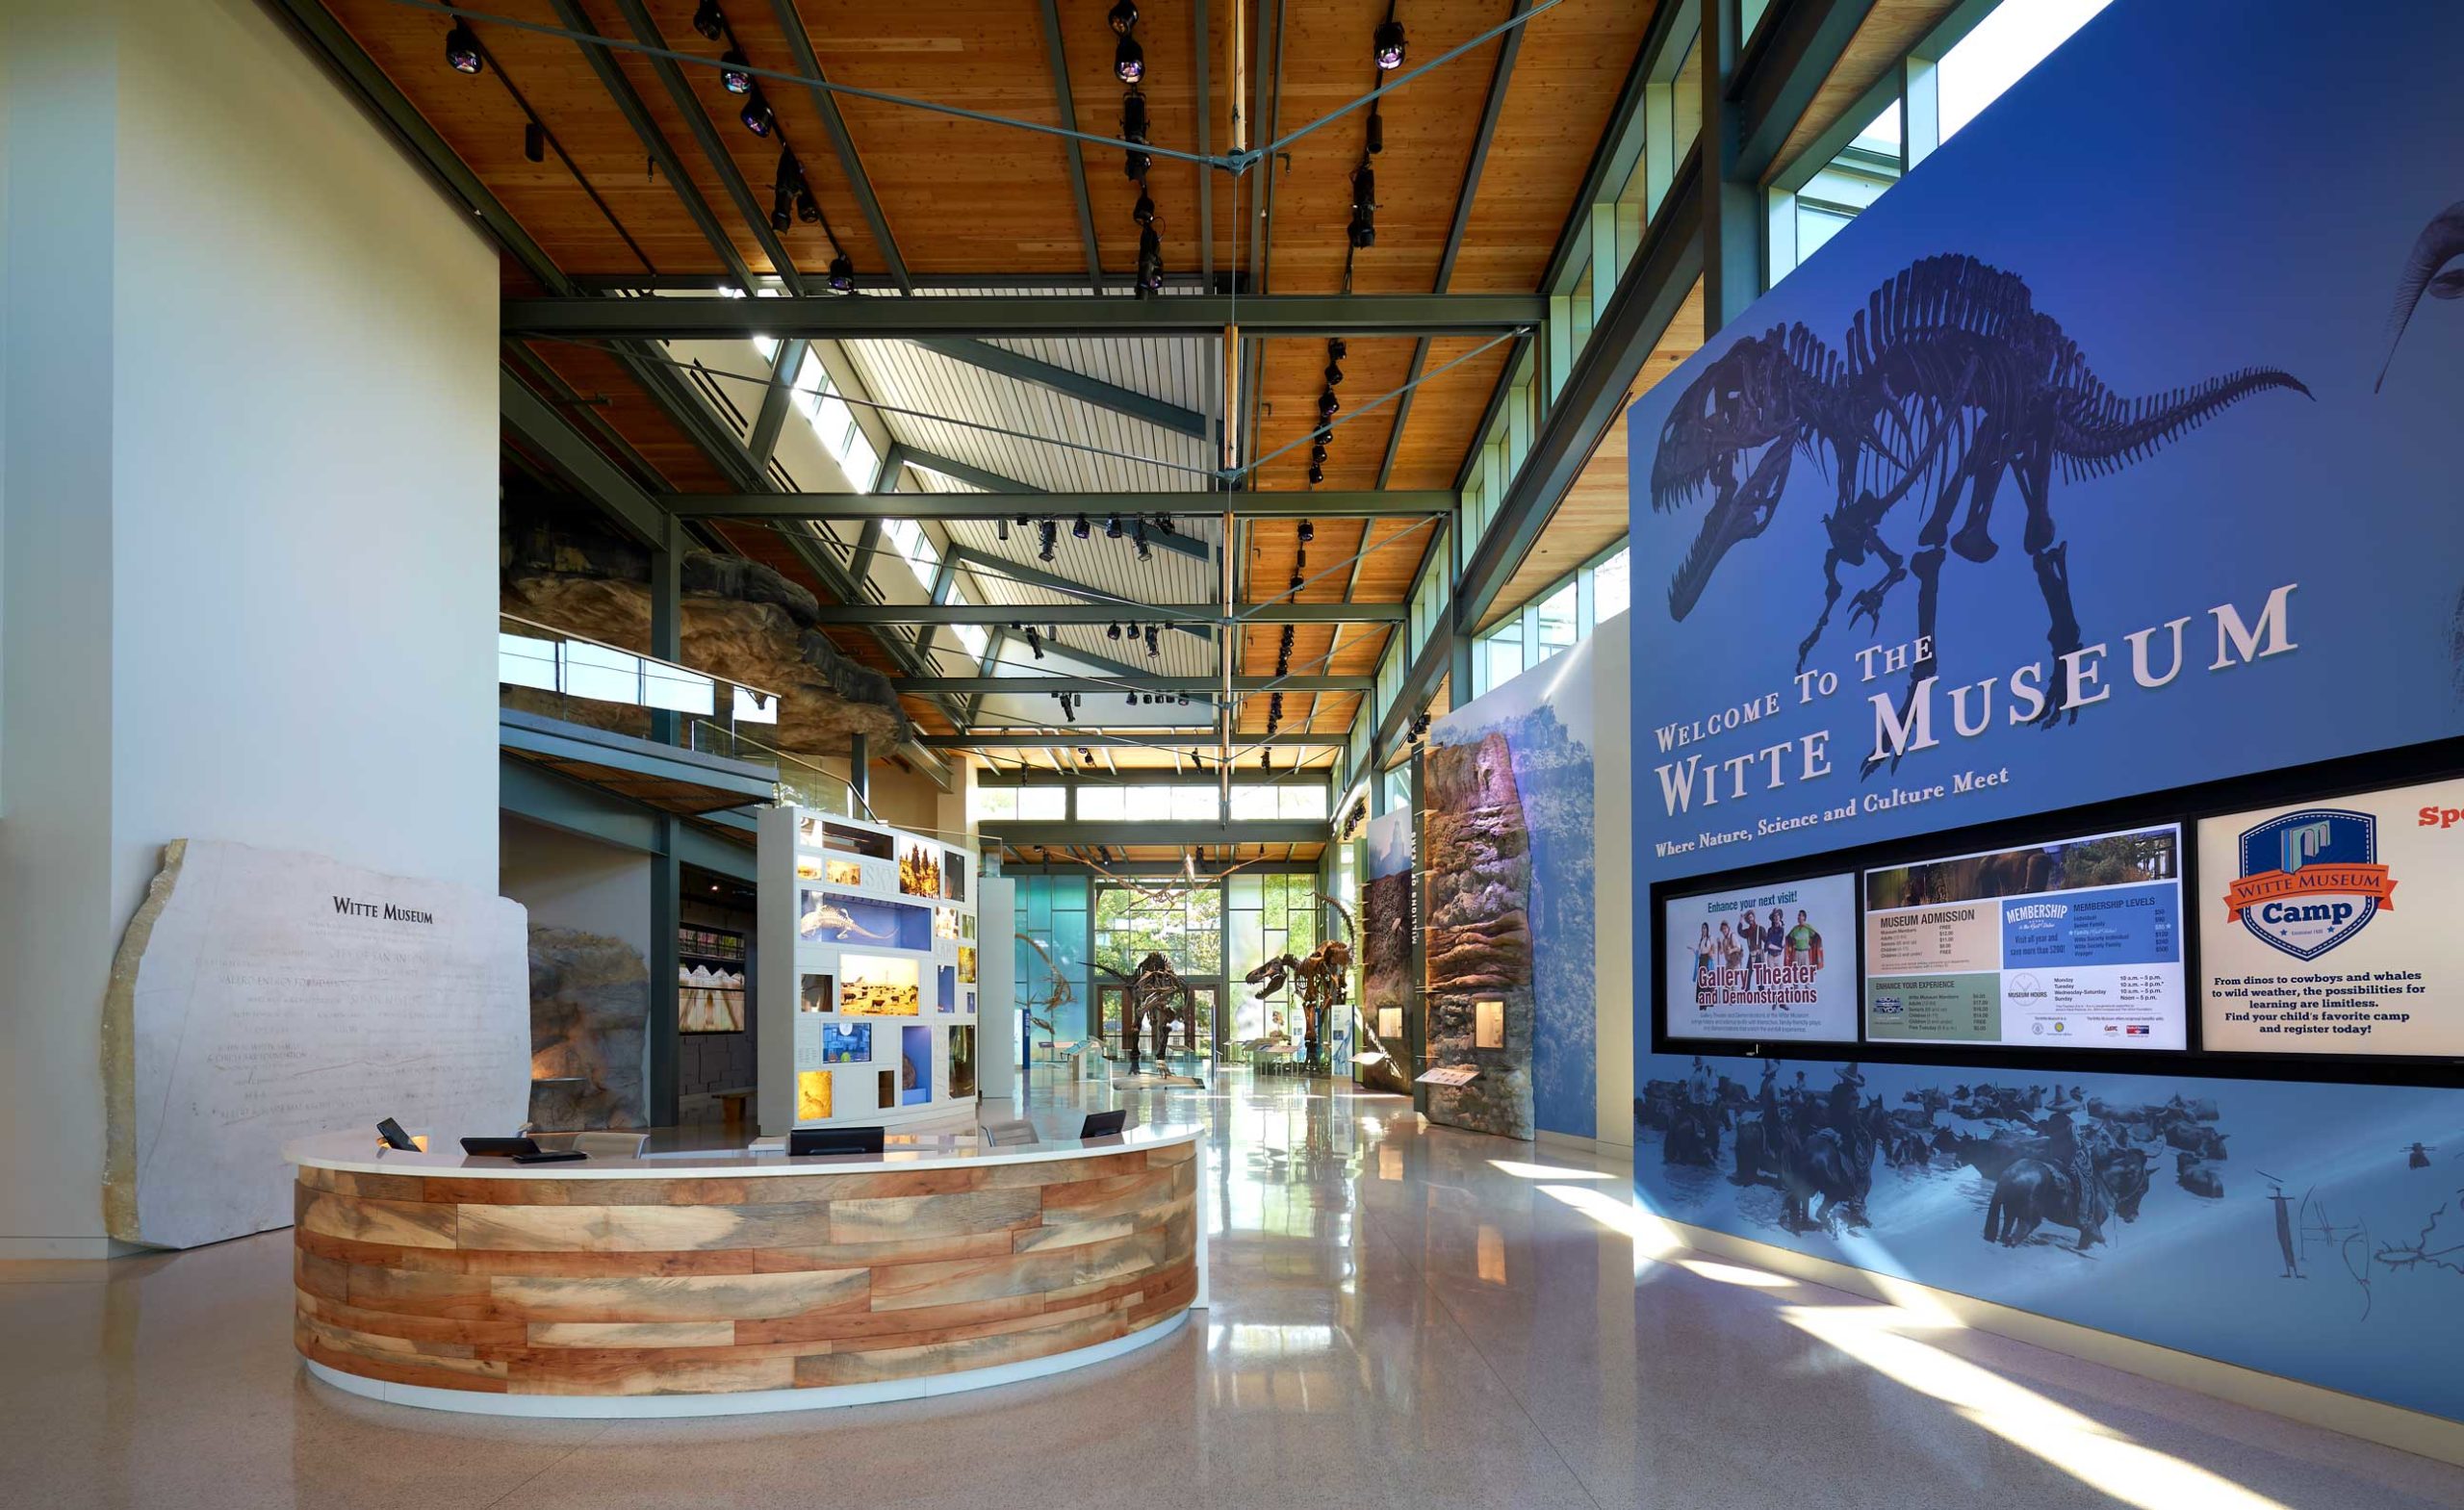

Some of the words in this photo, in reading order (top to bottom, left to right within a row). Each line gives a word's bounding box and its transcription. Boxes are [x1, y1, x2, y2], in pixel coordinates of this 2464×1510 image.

[1655, 692, 1781, 754] WELCOME
[1794, 669, 1838, 704] TO
[1855, 634, 1934, 682] THE
[1655, 729, 1832, 817] WITTE
[1867, 582, 2298, 762] MUSEUM
[1656, 839, 1695, 858] Where
[1699, 829, 1753, 850] Nature,
[1758, 812, 1818, 836] Science
[1824, 799, 1857, 822] and
[1863, 784, 1944, 812] Culture
[1952, 766, 2009, 795] Meet
[2418, 806, 2464, 829] Sp
[2238, 876, 2294, 899] WITTE
[2298, 872, 2381, 888] MUSEUM
[333, 896, 378, 919] WITTE
[383, 902, 433, 925] MUSEUM
[1707, 901, 1738, 913] Enhance
[1740, 897, 1757, 911] your
[1758, 894, 1775, 907] next
[1777, 890, 1798, 905] visit!
[2073, 899, 2123, 912] MEMBERSHIP
[2125, 897, 2155, 908] LEVELS
[1880, 914, 1919, 928] MUSEUM
[1921, 909, 1975, 925] ADMISSION
[2006, 903, 2068, 924] MEMBERSHIP
[2262, 902, 2352, 925] Camp
[2015, 934, 2025, 944] Visit
[2034, 935, 2046, 945] year
[2047, 933, 2058, 942] and
[2037, 945, 2048, 955] than
[1699, 965, 1748, 990] Gallery
[1753, 961, 1817, 985] Theater
[2214, 977, 2241, 985] From
[2244, 975, 2274, 985] dinos
[2276, 975, 2288, 984] to
[2290, 974, 2343, 985] cowboys
[2346, 972, 2371, 982] and
[2373, 971, 2422, 981] whales
[1699, 989, 1718, 1005] and
[1722, 987, 1817, 1005] Demonstrations
[2224, 987, 2248, 997] wild
[2250, 987, 2300, 998] weather,
[2302, 986, 2323, 996] the
[2325, 985, 2403, 998] possibilities
[2405, 984, 2426, 994] for
[2249, 1000, 2297, 1010] learning
[2322, 999, 2378, 1009] limitless.
[2225, 1012, 2250, 1021] Find
[2252, 1013, 2277, 1023] your
[2280, 1011, 2319, 1021] child's
[2322, 1011, 2371, 1021] favorite
[2374, 1012, 2409, 1023] camp
[2259, 1024, 2281, 1033] and
[2284, 1025, 2329, 1035] register
[2332, 1024, 2372, 1035] today!
